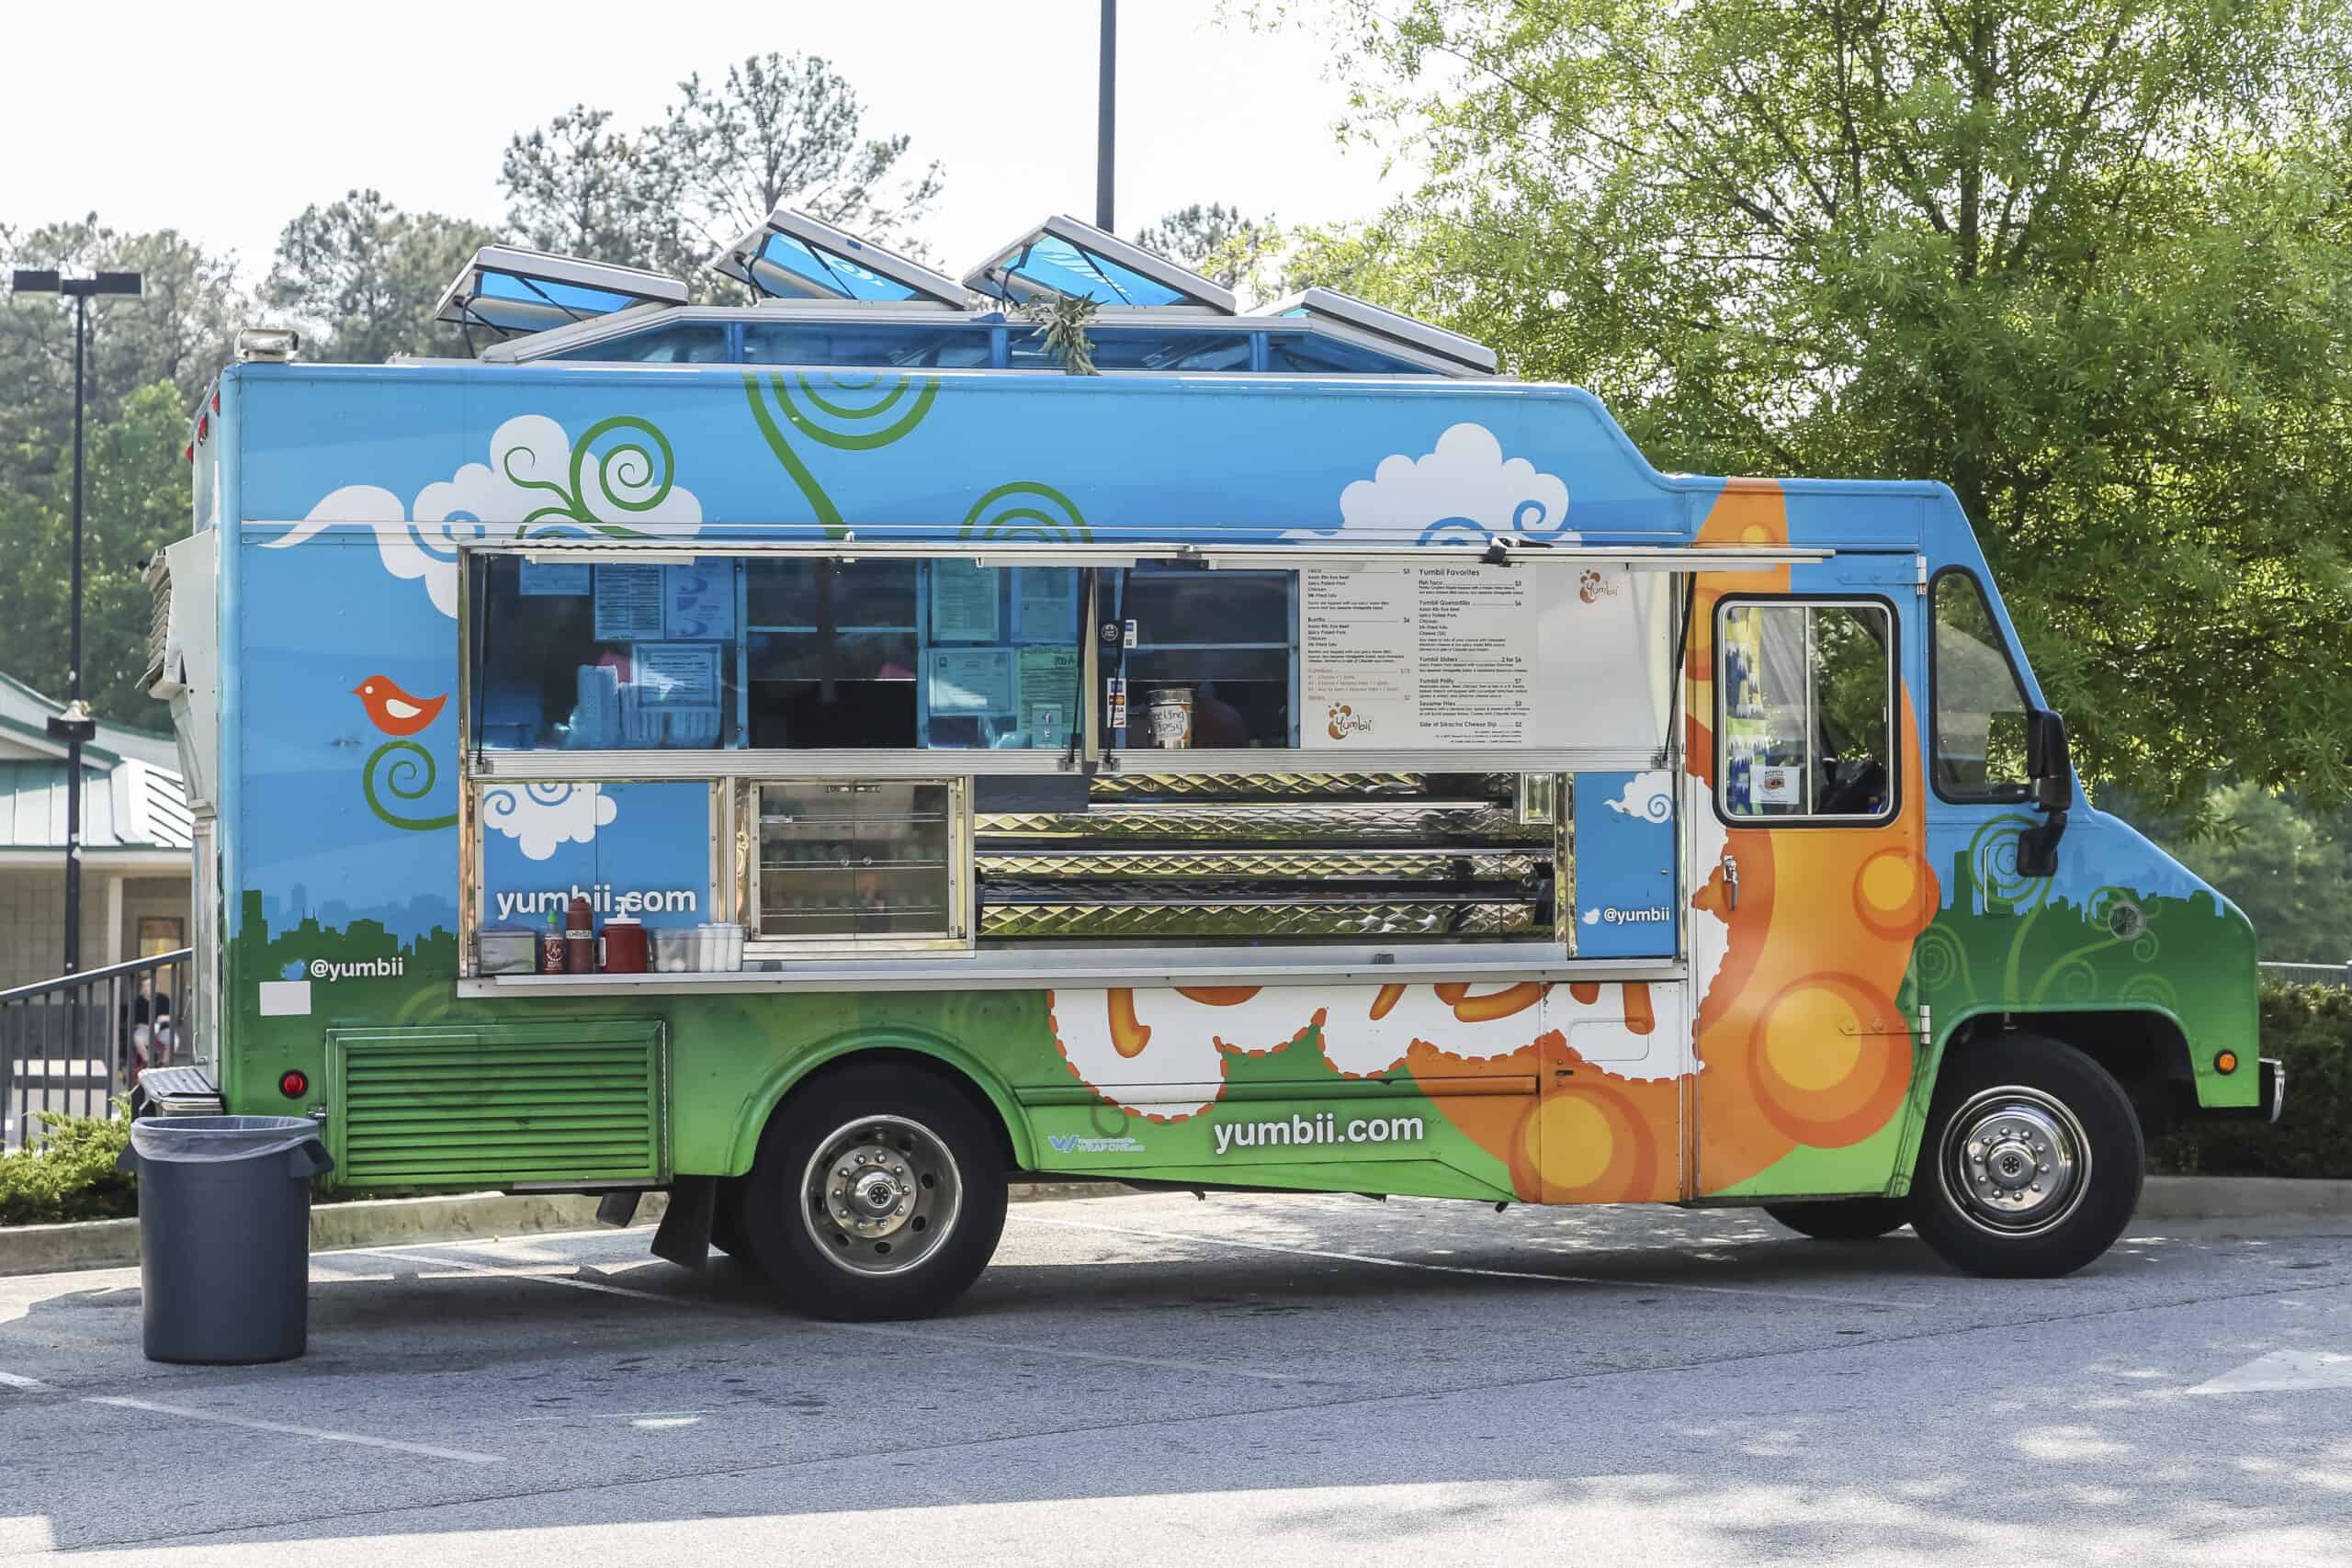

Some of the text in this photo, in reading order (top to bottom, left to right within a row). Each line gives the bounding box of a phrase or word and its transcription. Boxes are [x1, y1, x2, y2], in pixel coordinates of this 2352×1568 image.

[1603, 907, 1670, 925] @yumbii
[311, 956, 404, 982] @yumbii
[1214, 1112, 1424, 1155] yumbii.com
